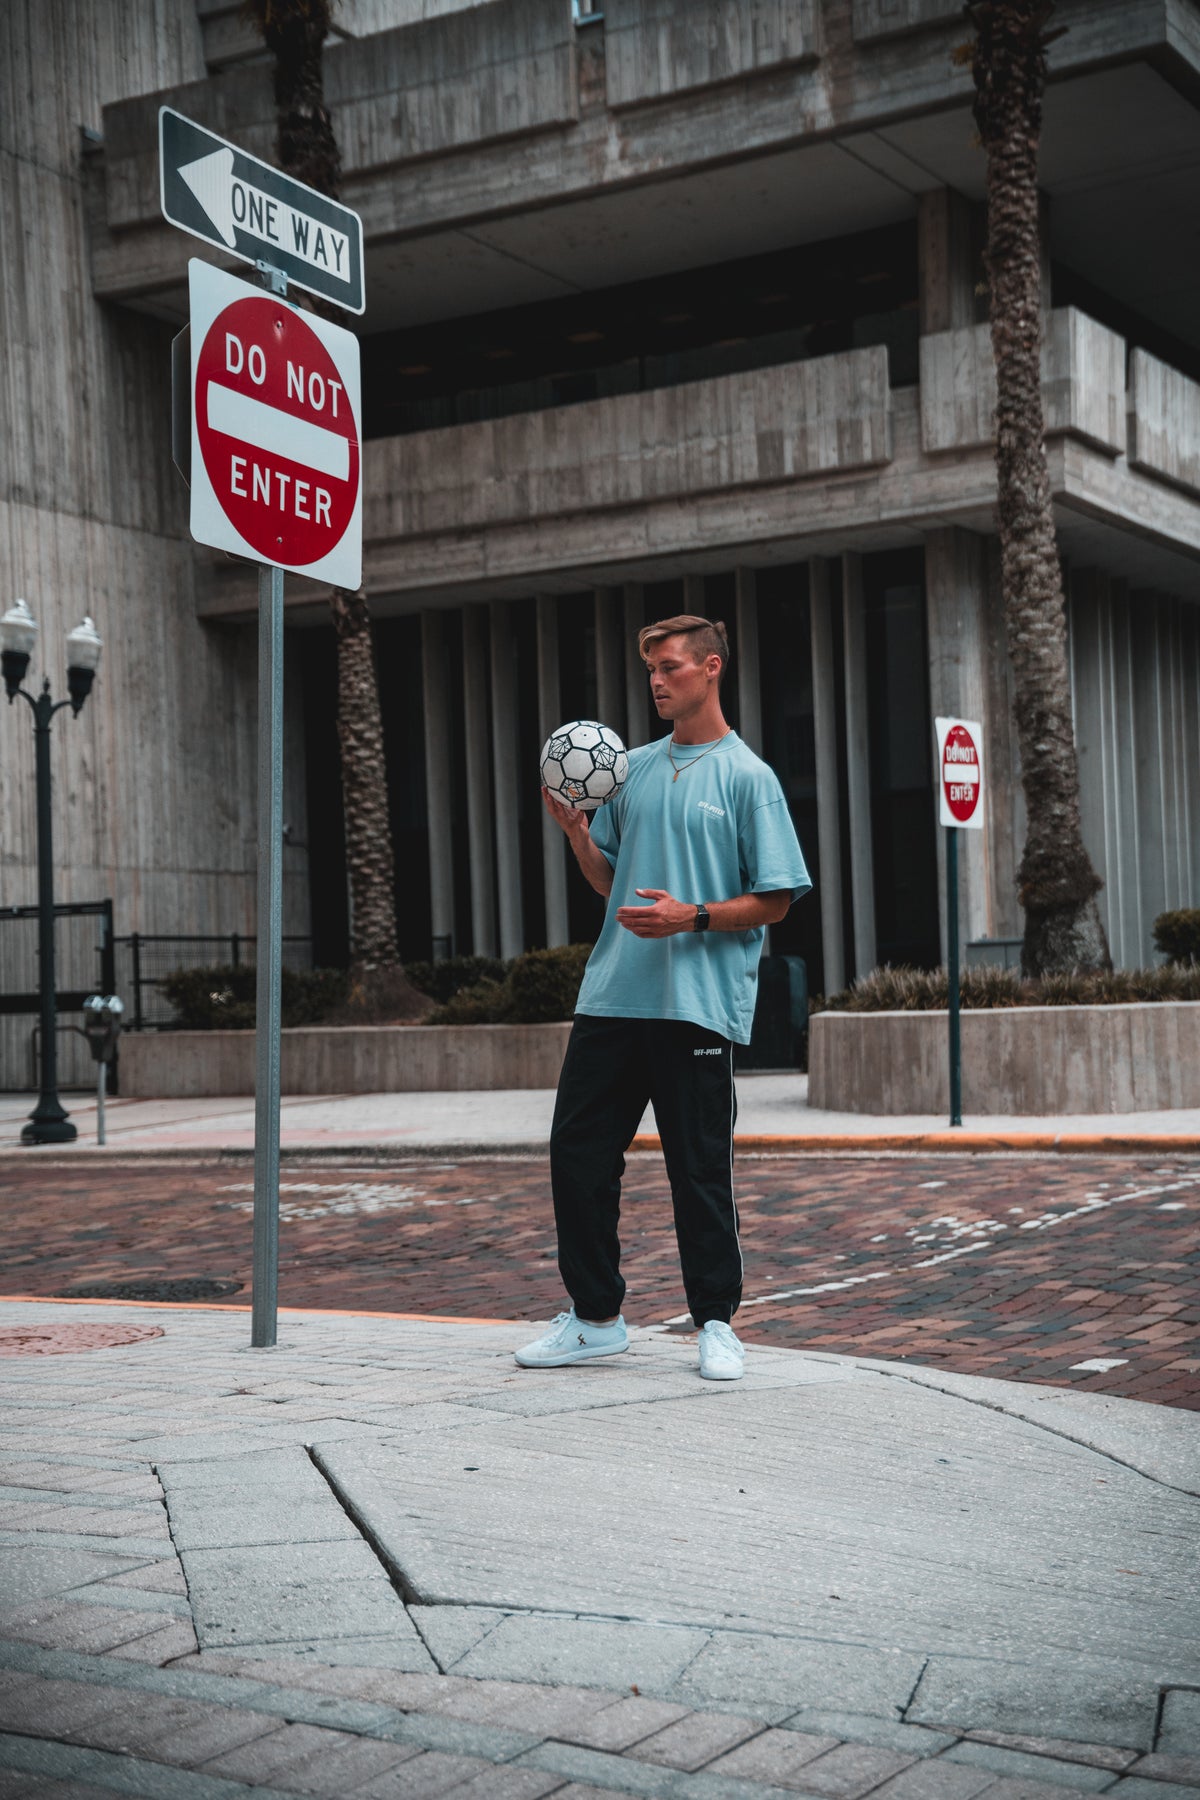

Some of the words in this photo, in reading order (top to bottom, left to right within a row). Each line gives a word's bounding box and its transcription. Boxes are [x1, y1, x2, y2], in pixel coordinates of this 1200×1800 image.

[232, 182, 279, 242] ONE
[291, 213, 344, 272] WAY
[225, 332, 267, 385] DO
[286, 360, 342, 418] NOT
[230, 454, 332, 528] ENTER
[946, 745, 957, 762] DO
[959, 746, 975, 763] NOT
[950, 785, 974, 801] ENTER
[693, 1048, 722, 1056] OFF-PITCH
